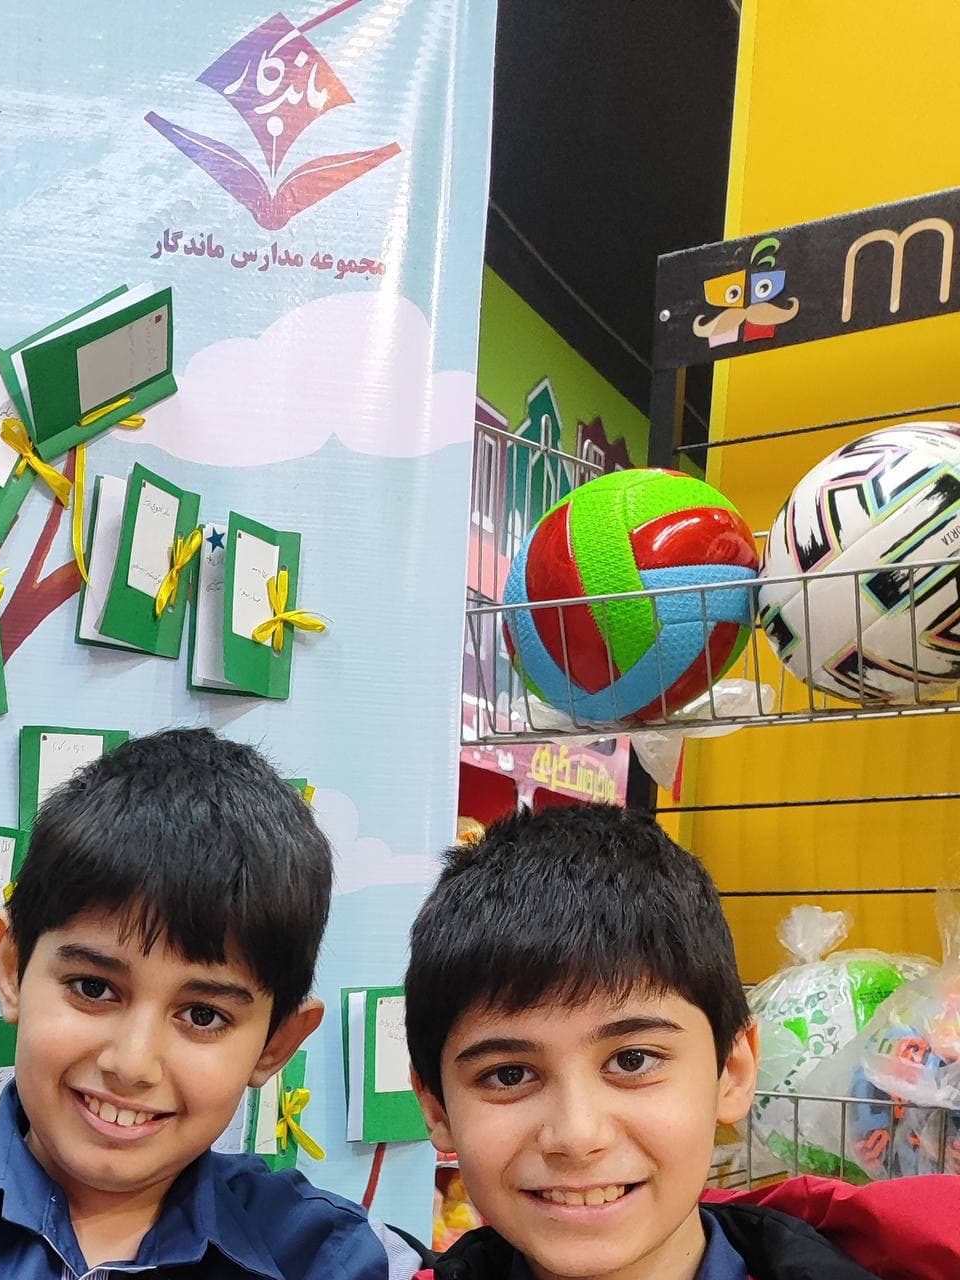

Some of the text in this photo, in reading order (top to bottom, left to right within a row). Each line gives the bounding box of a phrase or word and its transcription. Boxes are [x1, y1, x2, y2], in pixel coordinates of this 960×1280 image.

[150, 228, 386, 280] مجموعه مدارس ماندگار
